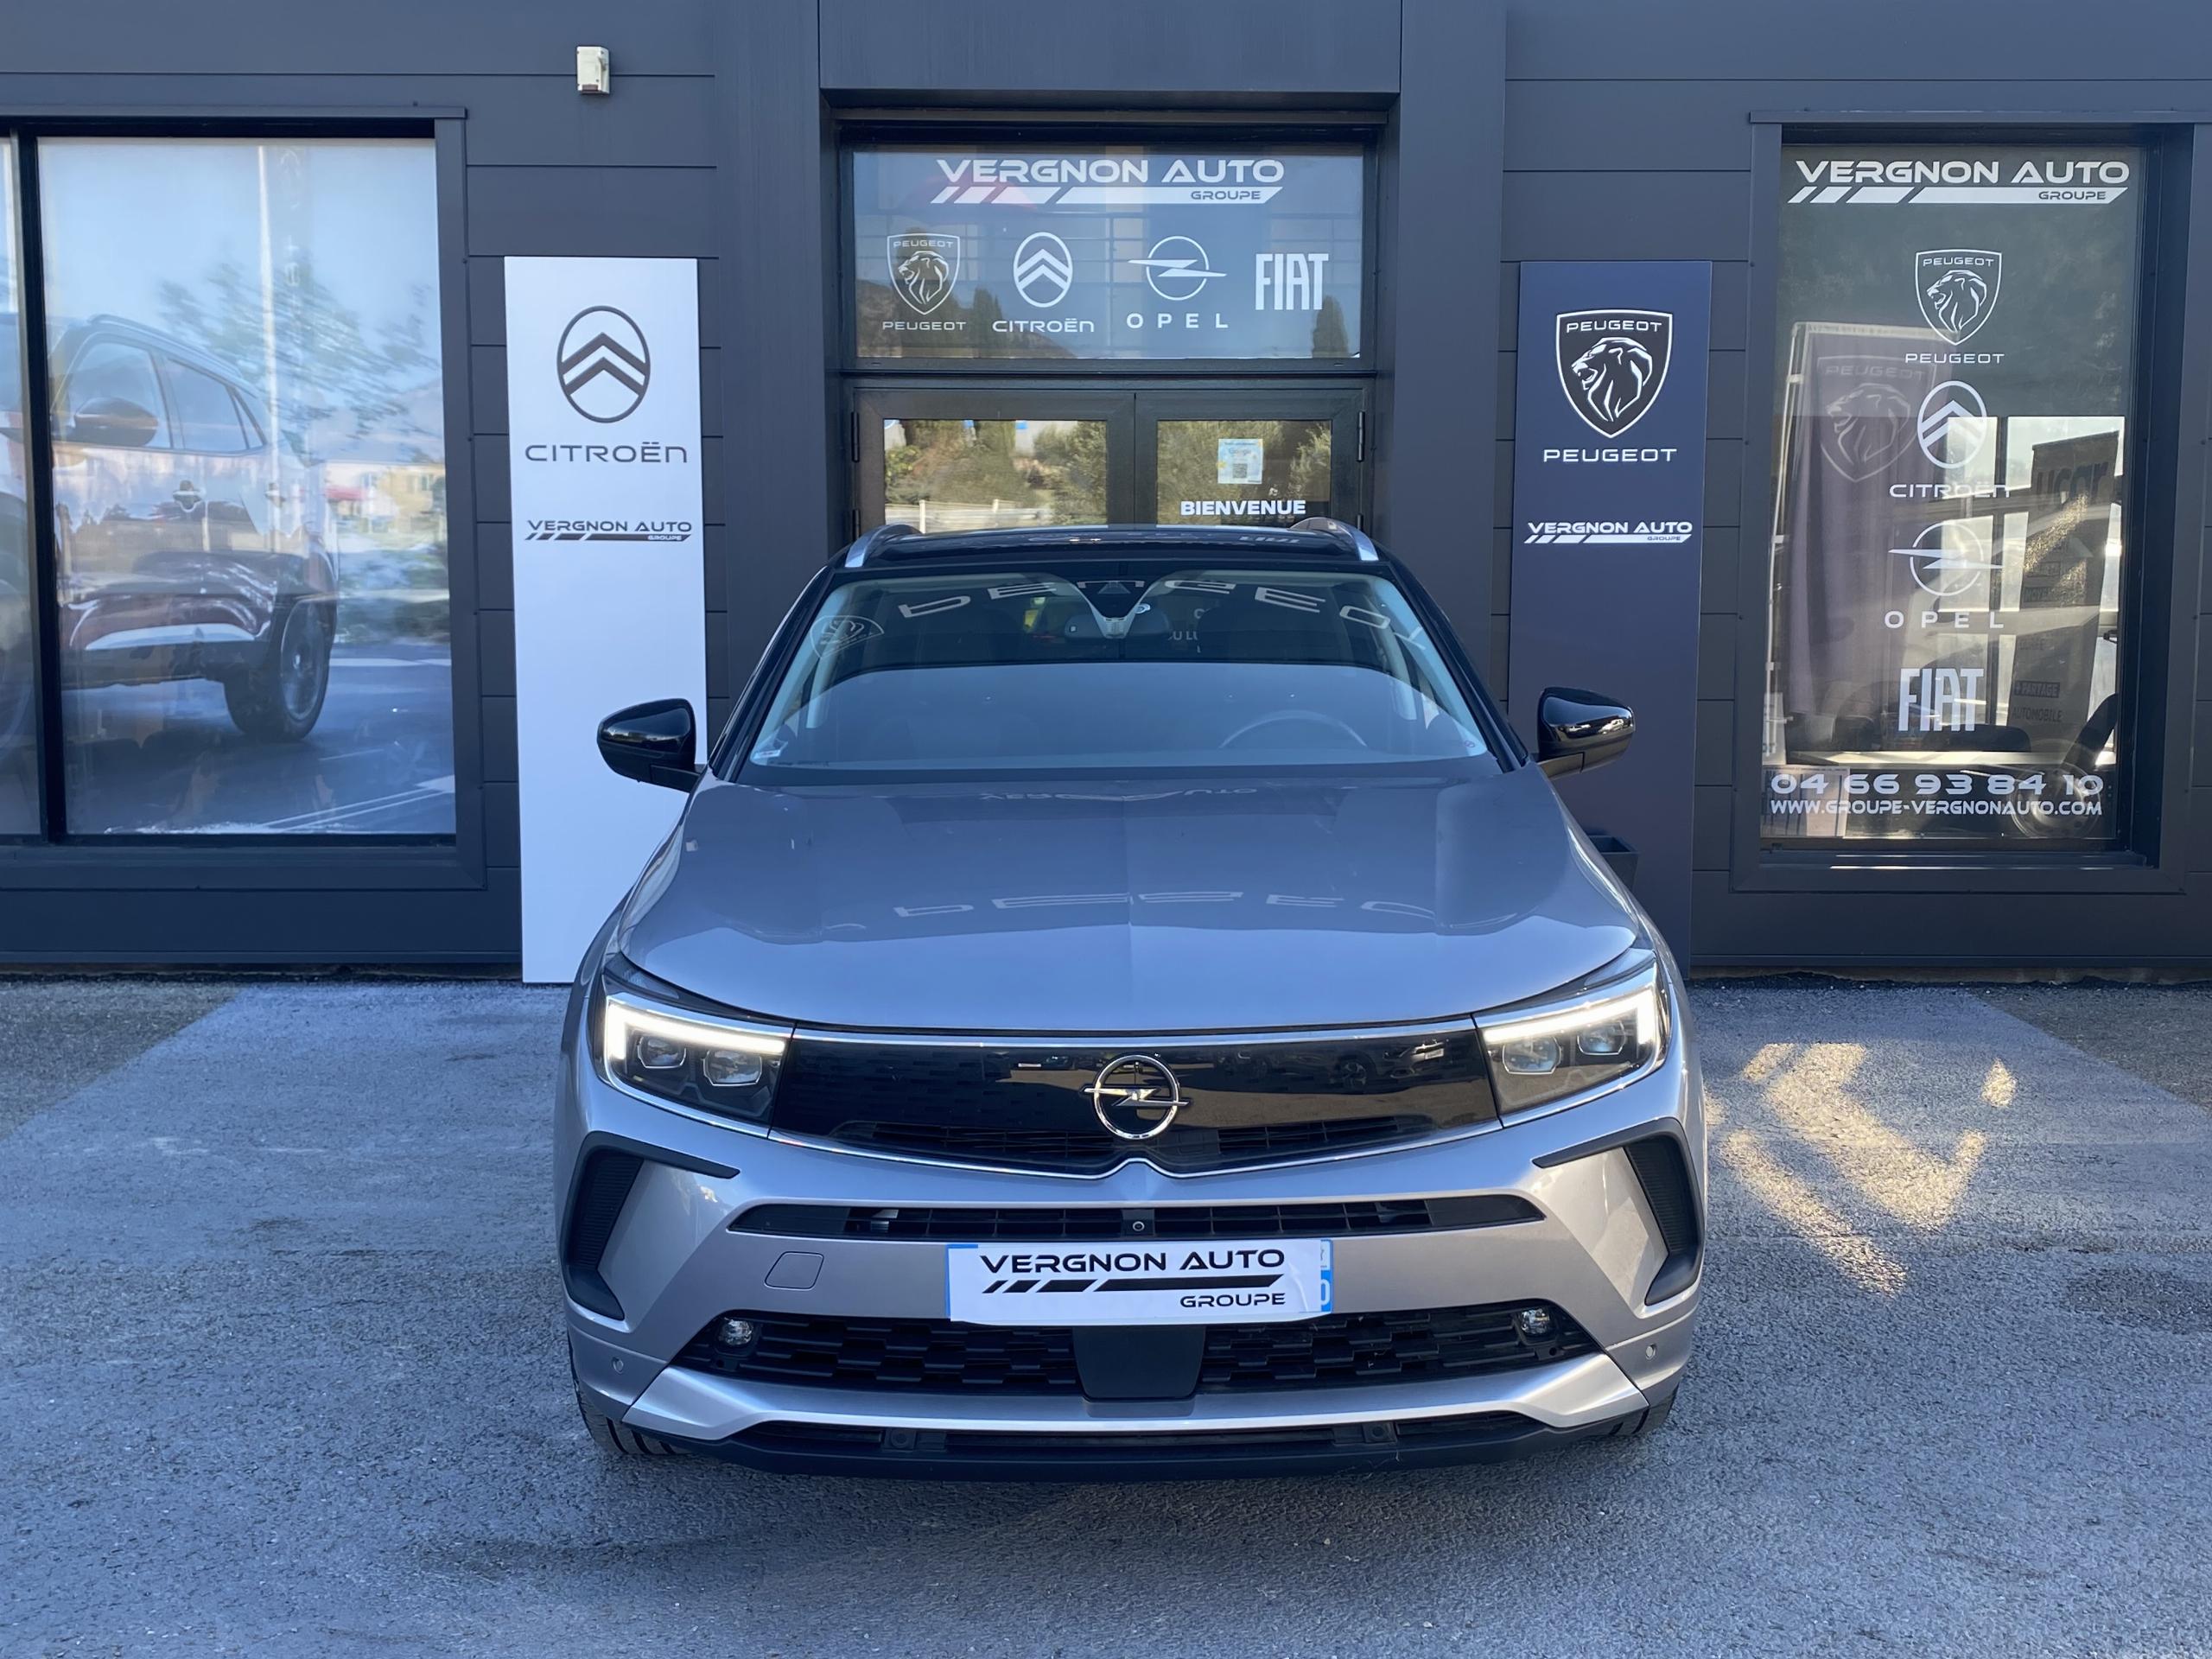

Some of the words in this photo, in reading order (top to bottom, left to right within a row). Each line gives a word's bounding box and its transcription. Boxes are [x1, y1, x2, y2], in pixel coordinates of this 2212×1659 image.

[937, 159, 1148, 183] VERGNON
[1161, 159, 1285, 183] AUTO
[1796, 160, 1999, 183] VERGNON
[2011, 161, 2130, 184] AUTO
[1191, 190, 1261, 200] GROUPE
[2038, 191, 2107, 200] GROUPE
[893, 240, 954, 249] PEUGEOT
[1923, 257, 1994, 267] PEUGEOT
[1255, 253, 1329, 310] FIAT
[883, 321, 967, 331] PEUGEOT
[1127, 313, 1229, 329] OPEL
[1567, 320, 1662, 334] PEUGEOT
[1905, 353, 2005, 365] PEUGEOT
[1543, 448, 1677, 462] PEUGEOT
[1180, 500, 1306, 516] BIENVENUE
[527, 520, 628, 532] VERGNON
[635, 521, 692, 533] AUTO
[1528, 522, 1628, 534] VERGNON
[1633, 522, 1693, 534] AUTO
[1885, 610, 2005, 629] OPEL
[1898, 668, 1985, 732] FIAT
[1770, 773, 1828, 795] 04
[1843, 773, 1900, 795] 66
[1915, 773, 1973, 795] 93
[1987, 773, 2048, 795] 84
[2064, 773, 2105, 795] 10
[1770, 799, 2103, 817] WWW.GROUPE-VERGNONAUTO.COM
[980, 1252, 1166, 1274] VERGNON
[1179, 1249, 1285, 1272] AUTO
[1179, 1292, 1286, 1308] GROUPE
